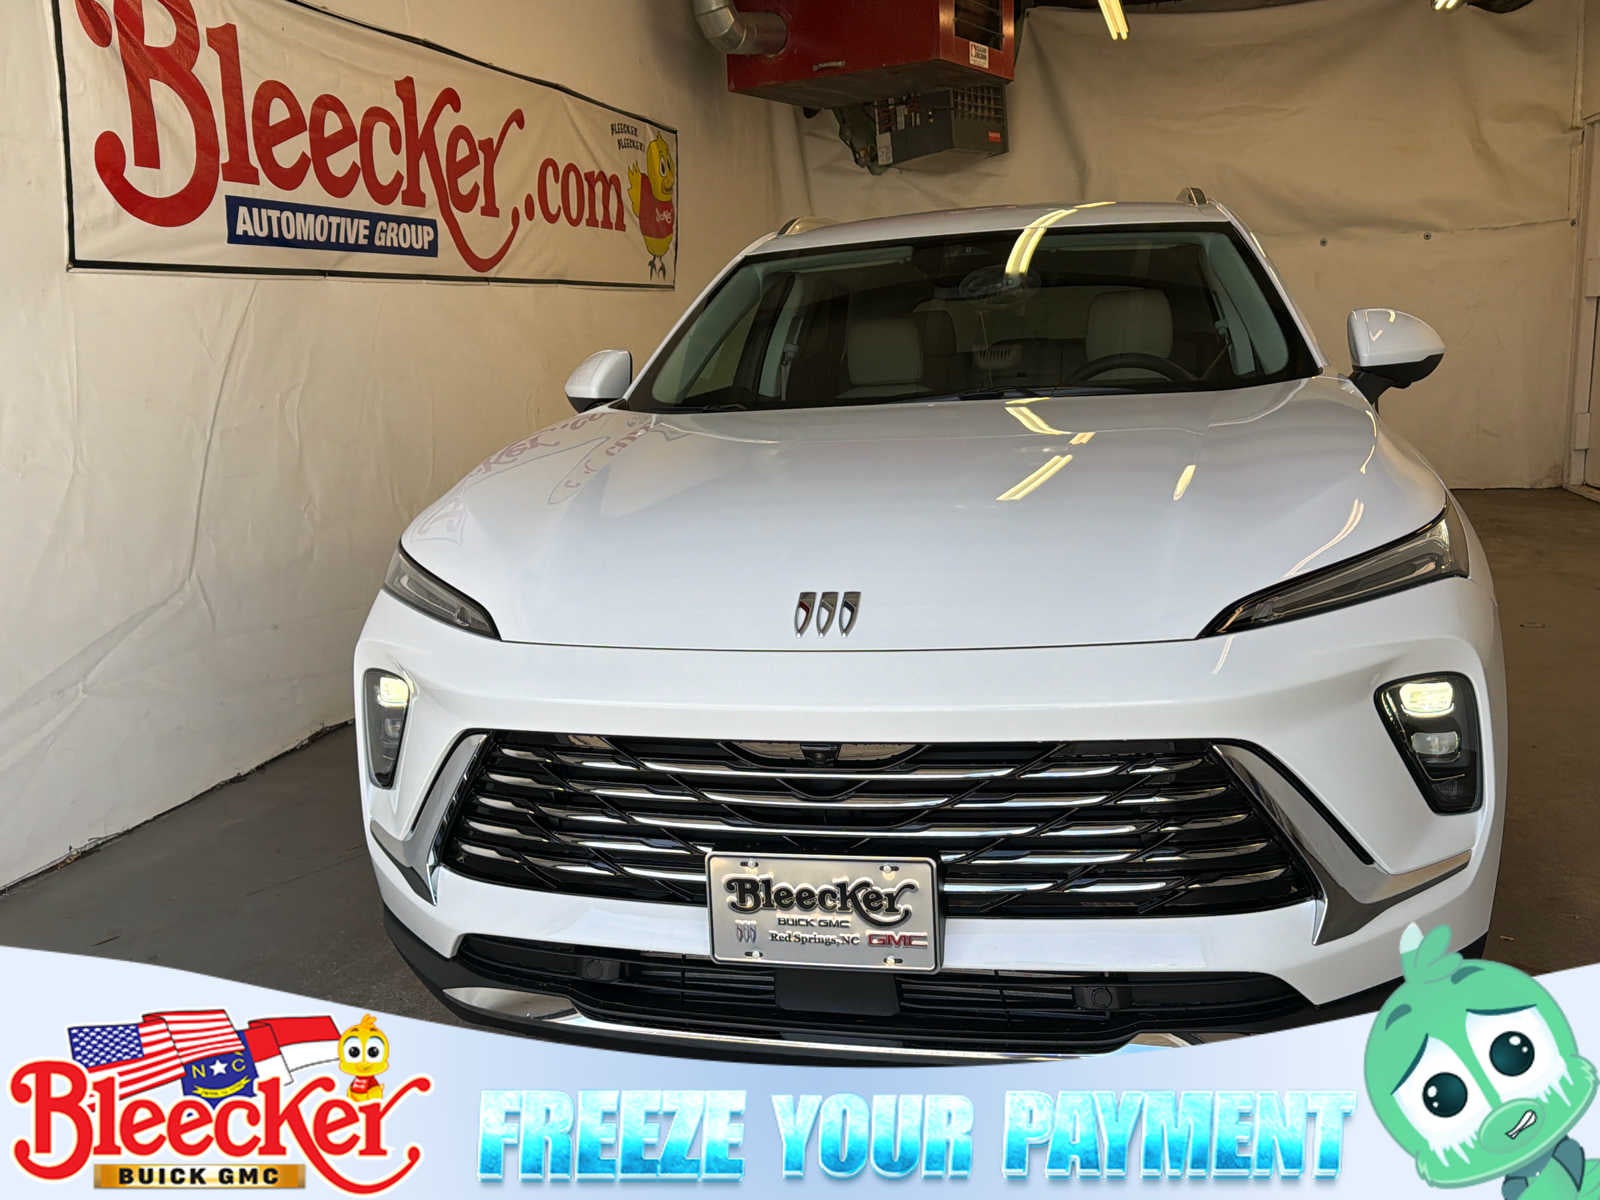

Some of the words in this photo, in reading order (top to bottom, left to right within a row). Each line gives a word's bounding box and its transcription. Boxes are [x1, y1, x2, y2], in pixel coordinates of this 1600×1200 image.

[235, 205, 370, 246] AUTOMOTIVE
[374, 217, 435, 250] GROUP
[777, 917, 815, 928] BUICK
[818, 918, 851, 929] GMC
[770, 932, 792, 943] Red
[841, 935, 860, 946] NC
[868, 933, 928, 948] GMC
